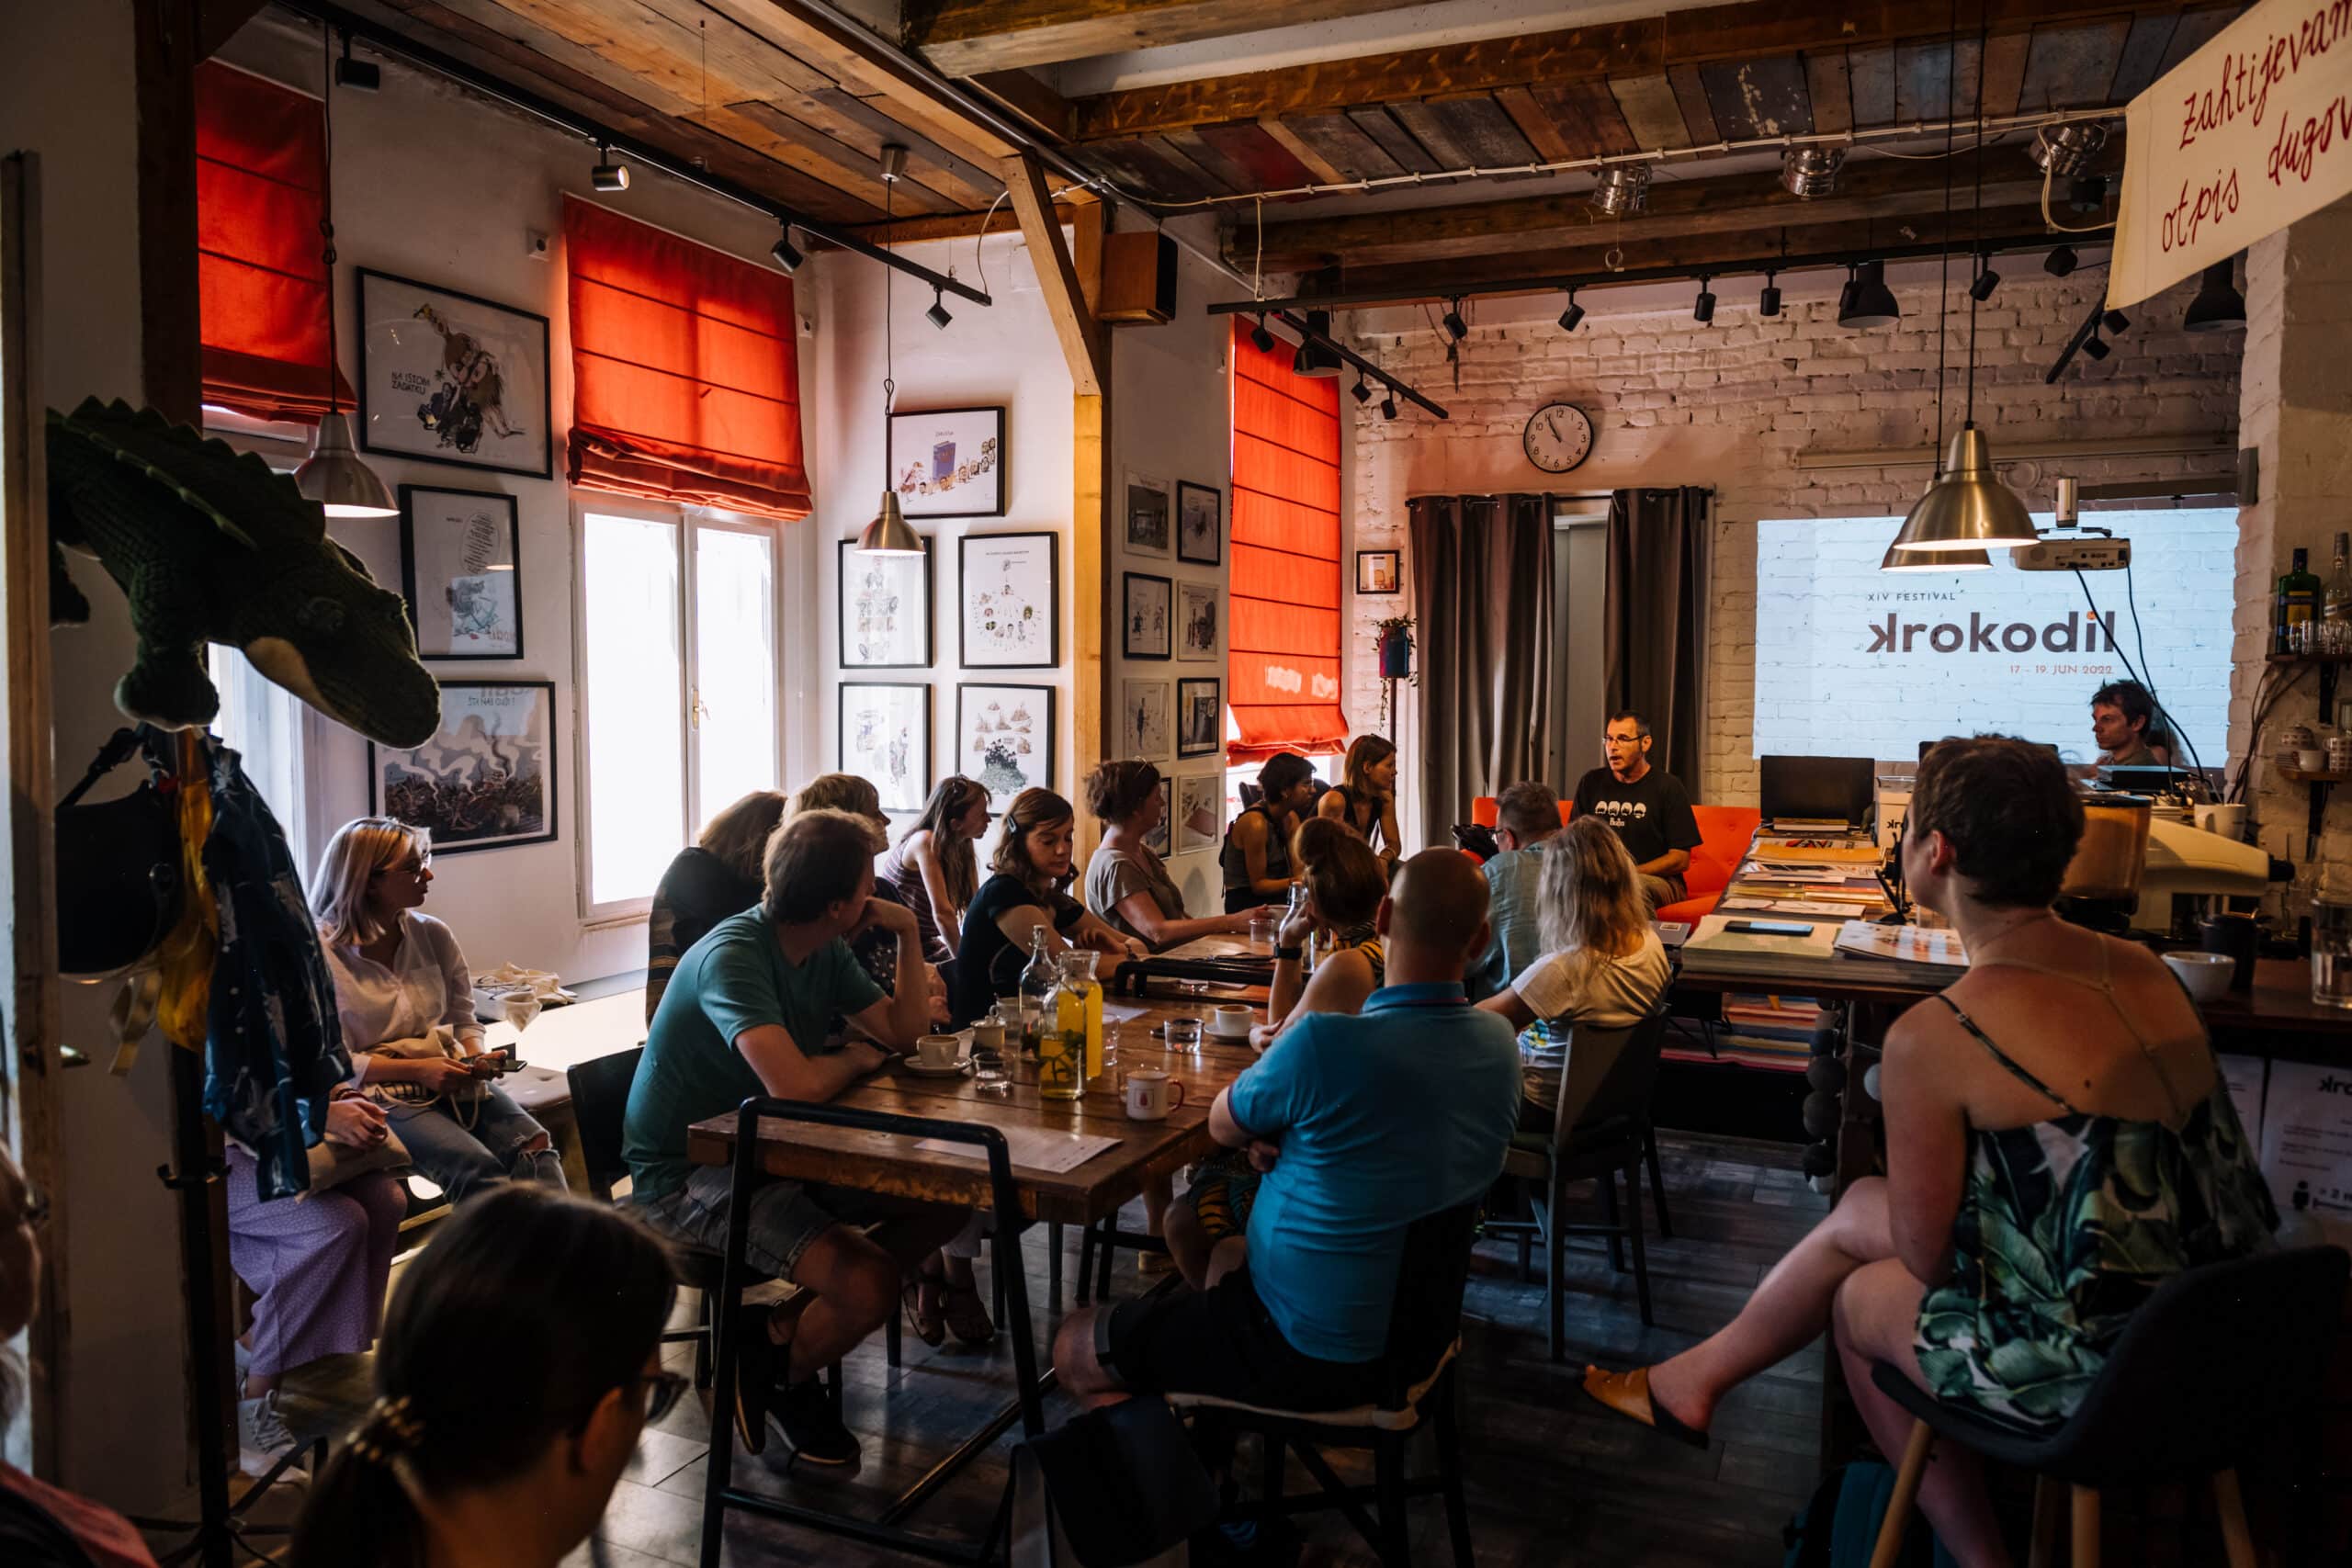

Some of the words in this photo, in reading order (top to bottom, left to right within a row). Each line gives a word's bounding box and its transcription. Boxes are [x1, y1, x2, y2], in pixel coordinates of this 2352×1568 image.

[2162, 167, 2240, 253] otpis
[1556, 410, 1565, 418] 12
[1535, 422, 1544, 431] 10
[1577, 422, 1583, 430] 2
[1530, 434, 1536, 443] 9
[1581, 434, 1587, 443] 3
[1533, 446, 1540, 456] 8
[1576, 447, 1581, 456] 4
[1544, 456, 1549, 464] 7
[1554, 459, 1560, 468] 6
[1566, 456, 1572, 464] 5
[1868, 592, 1889, 602] XIV
[1896, 592, 1956, 602] FESTIVAL
[1865, 611, 2116, 653] krokodil
[2010, 664, 2020, 674] 17
[2052, 664, 2077, 675] JUN
[2082, 665, 2113, 674] 2022
